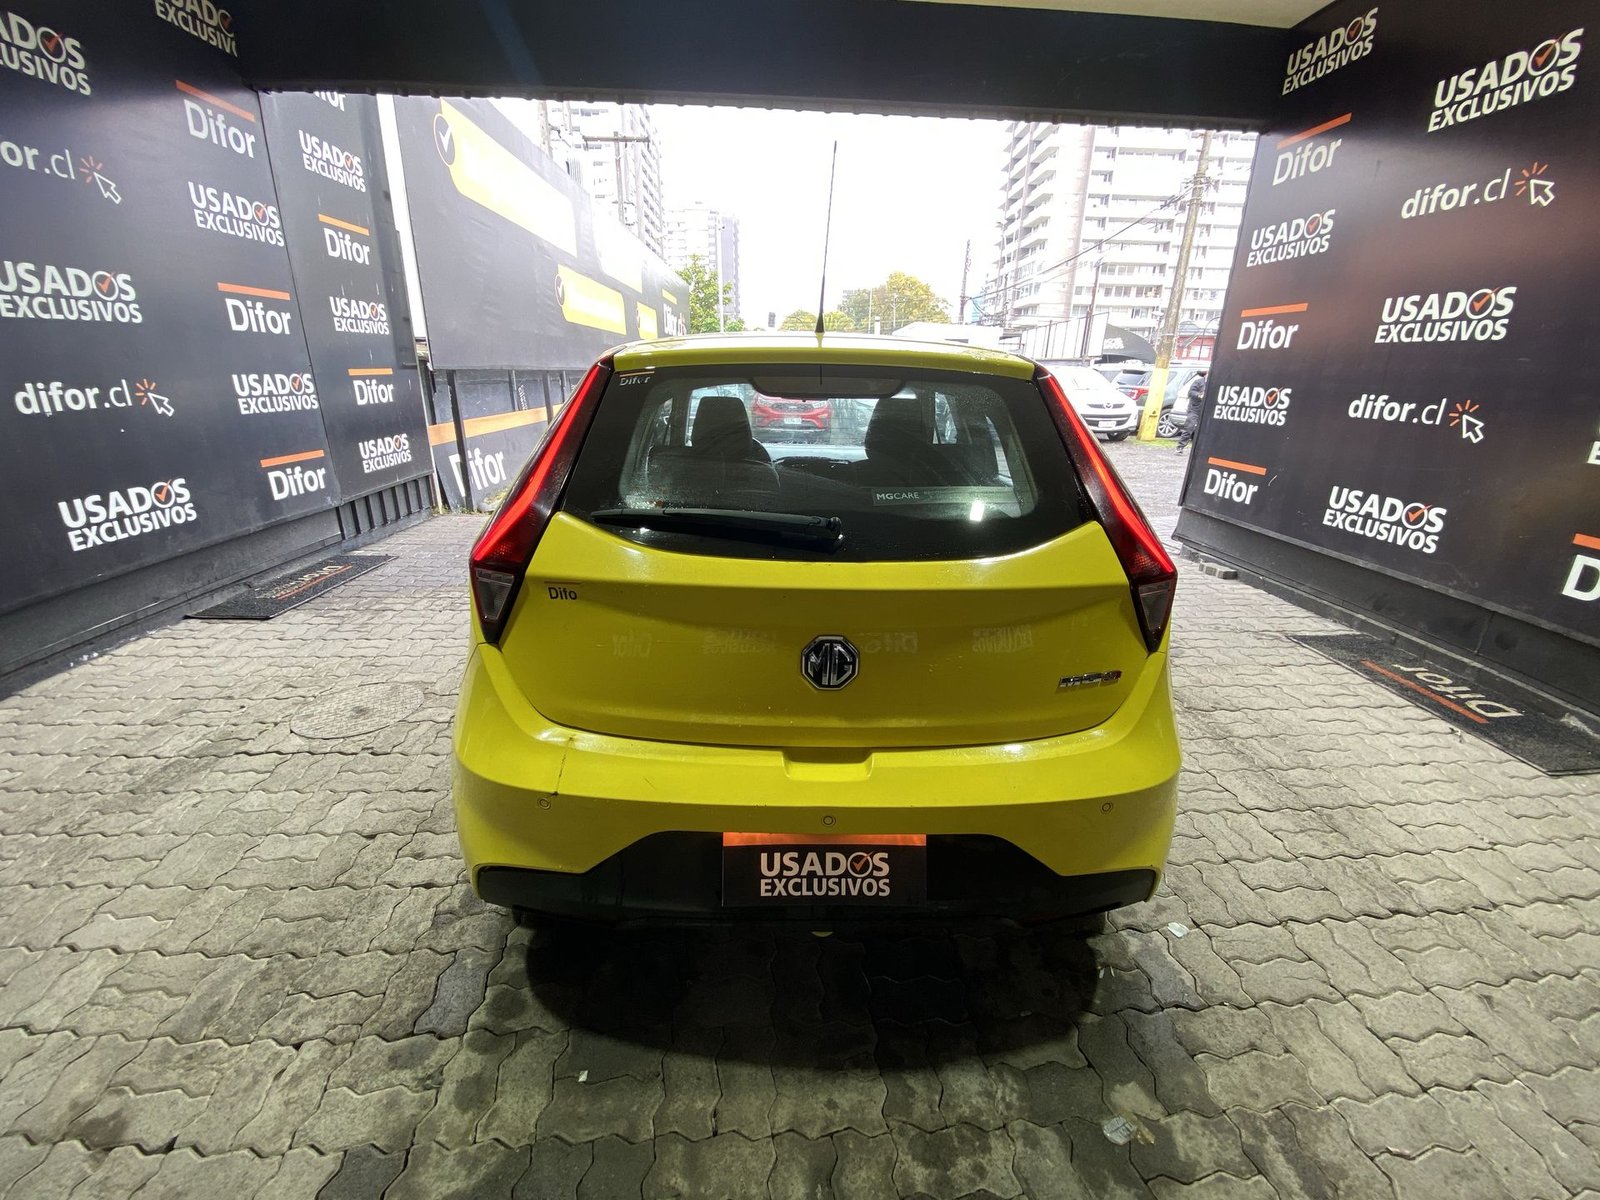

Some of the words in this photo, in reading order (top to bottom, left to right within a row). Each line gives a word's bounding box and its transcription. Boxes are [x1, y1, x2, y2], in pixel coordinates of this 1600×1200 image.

[1286, 7, 1379, 75] USADOS
[1282, 35, 1375, 96] EXCLUSIVOS
[1435, 27, 1585, 108] USADOS
[1427, 64, 1578, 133] EXCLUSIVOS
[183, 99, 256, 159] Difor
[299, 129, 363, 177] USADOS
[1272, 138, 1343, 186] Difor
[303, 153, 367, 193] EXCLUSIVOS
[188, 181, 281, 230] USADOS
[1401, 168, 1511, 219] difor.cl
[193, 208, 285, 248] EXCLUSIVOS
[1251, 208, 1336, 250] USADOS
[323, 228, 371, 266] Difor
[1246, 234, 1332, 268] EXCLUSIVOS
[0, 294, 143, 324] EXCLUSIVOS
[225, 297, 291, 335] Difor
[329, 296, 388, 322] USADOS
[1381, 286, 1518, 323] USADOS
[333, 317, 390, 336] EXCLUSIVOS
[1236, 319, 1299, 350] Difor
[1374, 318, 1510, 344] EXCLUSIVOS
[14, 379, 132, 416] difor.cl
[232, 373, 315, 397] USADOS
[353, 379, 394, 406] Difor
[1217, 385, 1292, 410] USADOS
[237, 395, 319, 415] EXCLUSIVOS
[1213, 405, 1288, 427] EXCLUSIVOS
[1348, 393, 1447, 425] difor.cl
[358, 433, 409, 460] USADOS
[362, 450, 412, 474] EXCLUSIVOS
[58, 477, 191, 528] USADOS
[267, 467, 326, 501] Difor
[876, 491, 920, 500] MGCARE
[1203, 468, 1258, 505] Difor
[67, 502, 198, 552] EXCLUSIVOS
[1329, 485, 1448, 534] USADOS
[1322, 508, 1440, 554] EXCLUSIVOS
[807, 642, 853, 686] MG
[760, 851, 890, 877] USADOS
[760, 877, 891, 897] EXCLUSIVOS
